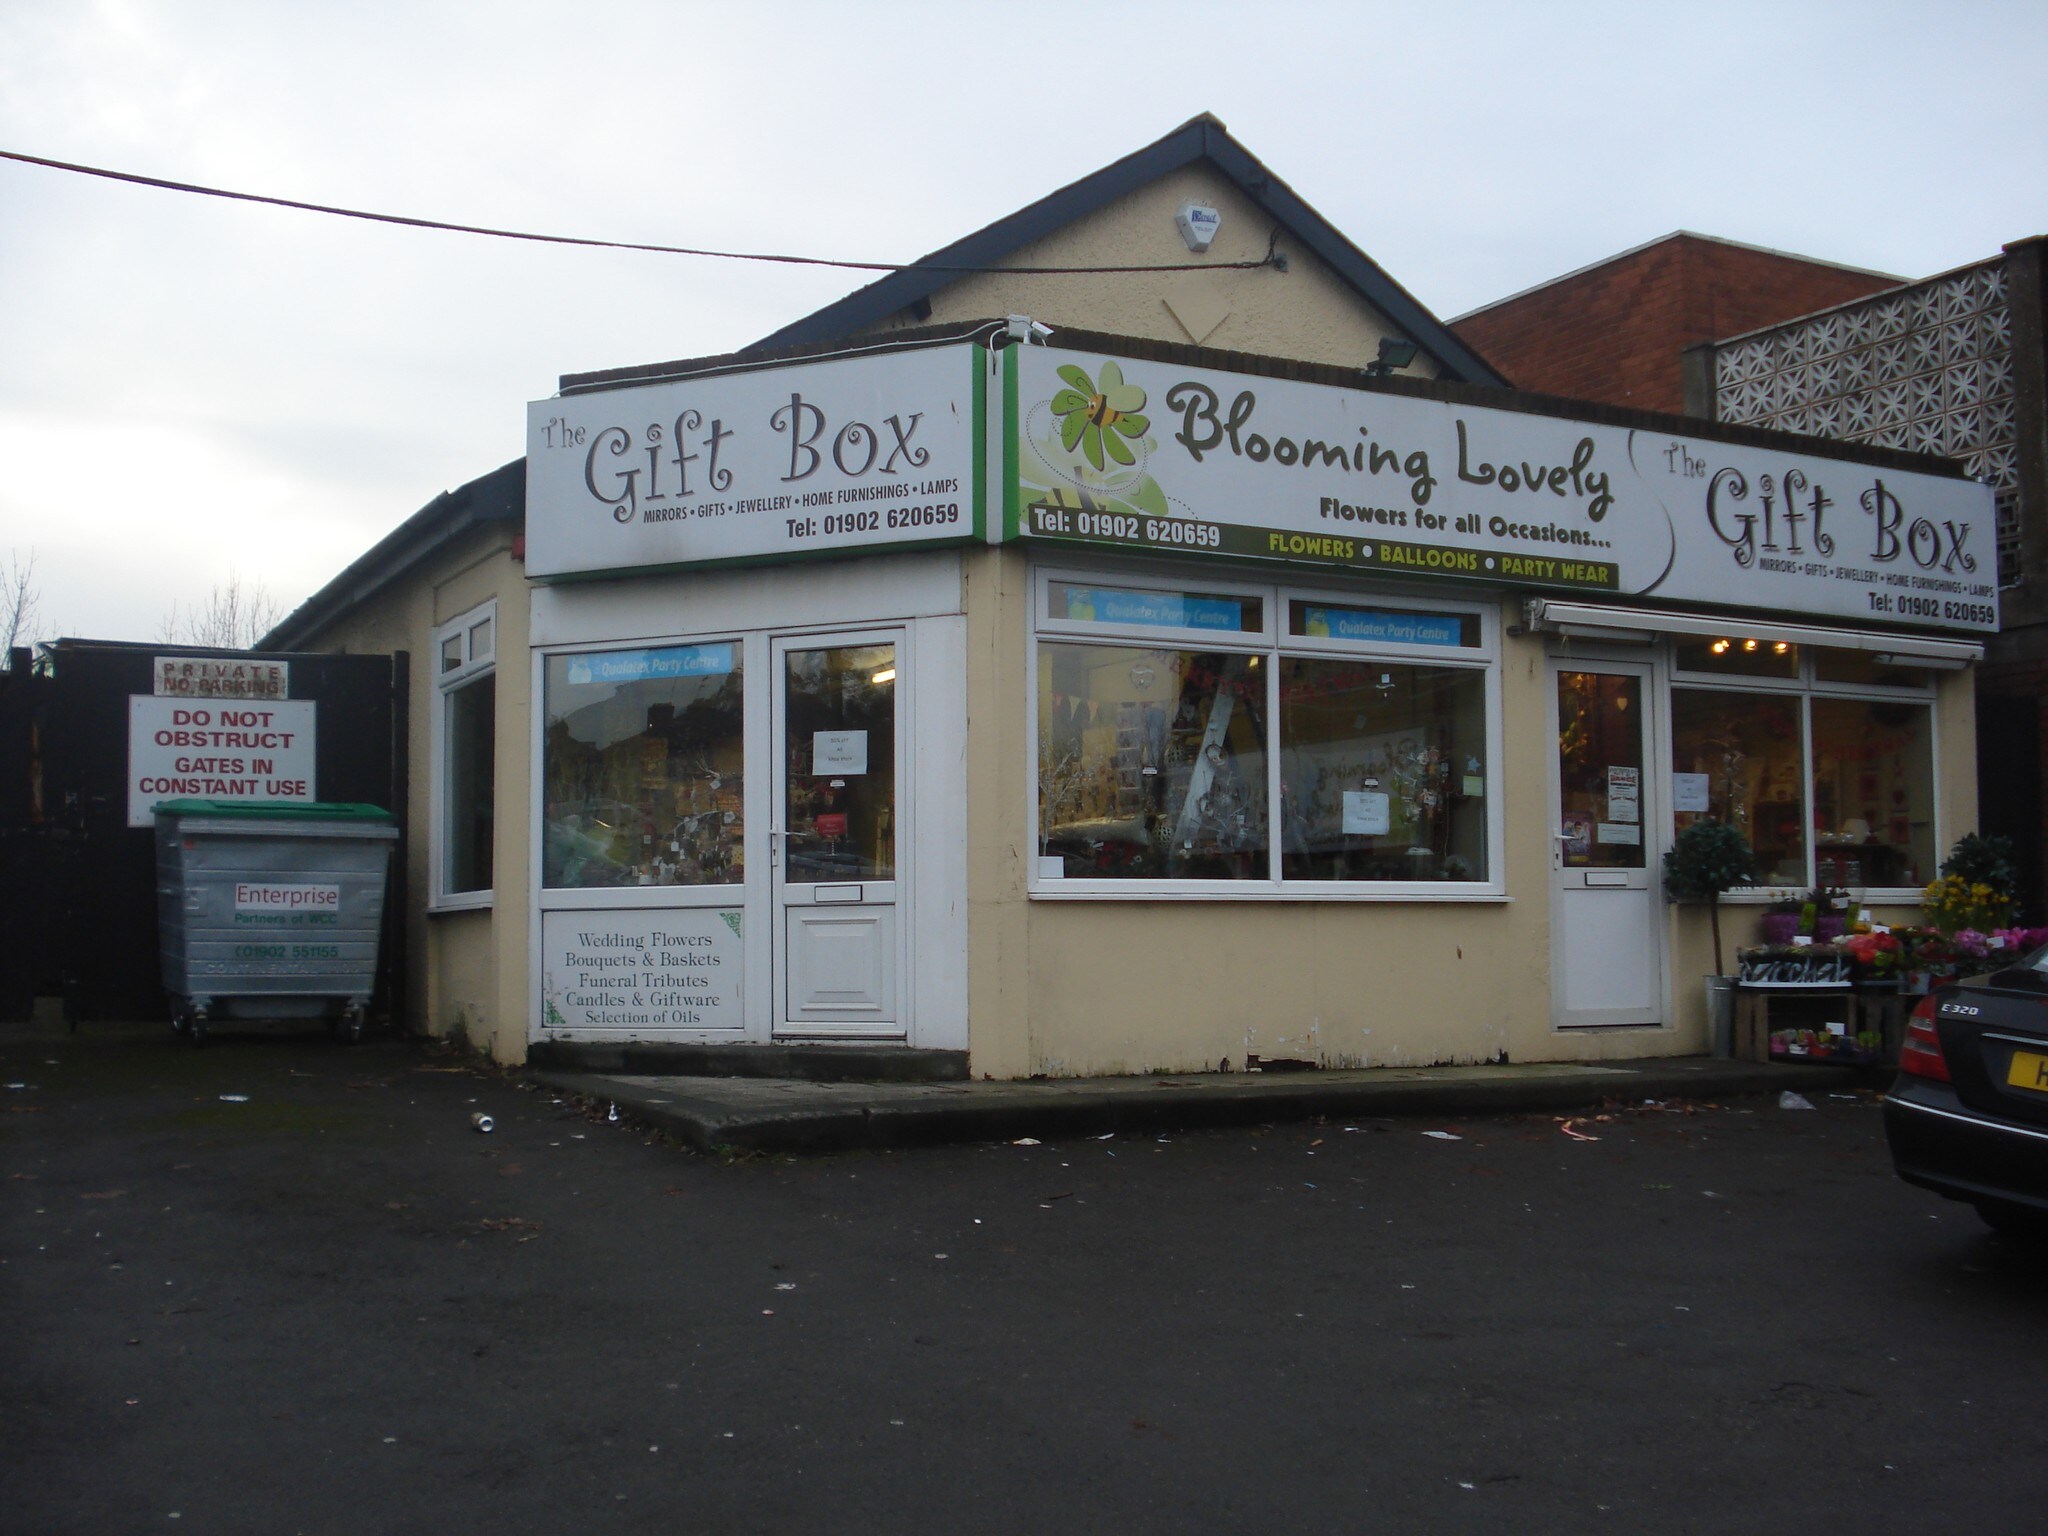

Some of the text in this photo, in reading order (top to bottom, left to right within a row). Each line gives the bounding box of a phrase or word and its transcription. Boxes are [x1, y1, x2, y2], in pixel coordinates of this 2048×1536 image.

[541, 417, 586, 448] The
[584, 392, 930, 523] Gift Box
[1166, 381, 1614, 522] Blooming Lovely
[1664, 441, 1706, 478] The
[643, 478, 959, 524] MIRRORS GIFTS JEWELLERY HOME FURNISHINGS LAMPS
[786, 503, 959, 539] Tel: 01902 620659
[1034, 507, 1221, 548] Tel: 01902 620659
[1320, 497, 1612, 548] Flowers for all Occasions...
[1706, 467, 1977, 573] Gift Box
[1269, 533, 1608, 584] FLOWERS BALLOONS PARTY WEAR
[1759, 557, 1994, 598] MIRRORS GIFTS JEWELLERY HOME FURNISHINGS LAMPS
[1161, 608, 1191, 627] Party
[1194, 610, 1230, 625] Centre
[1868, 591, 1995, 625] Tel: 01902 620659
[1339, 619, 1449, 641] Qualatex Party Centre
[163, 663, 279, 679] PRIVATE
[651, 658, 681, 673] Party
[683, 655, 720, 670] Centre
[164, 678, 279, 694] NO PARKING
[172, 709, 274, 728] DO NOT
[154, 730, 295, 749] OBSTRUCT
[175, 757, 273, 774] GATES IN
[139, 777, 306, 796] CONSTANT USE
[237, 885, 338, 908] Enterprise
[235, 913, 286, 924] Partners
[309, 913, 337, 924] WCC
[578, 932, 713, 951] Wedding Flowers
[292, 945, 339, 958] 551155
[565, 952, 721, 971] Bouquets & Baskets
[579, 972, 709, 988] Funeral Tributes
[566, 991, 721, 1007] Candles & Giftware
[585, 1010, 701, 1024] Selection of Oils
[1941, 1003, 1979, 1016] E 320
